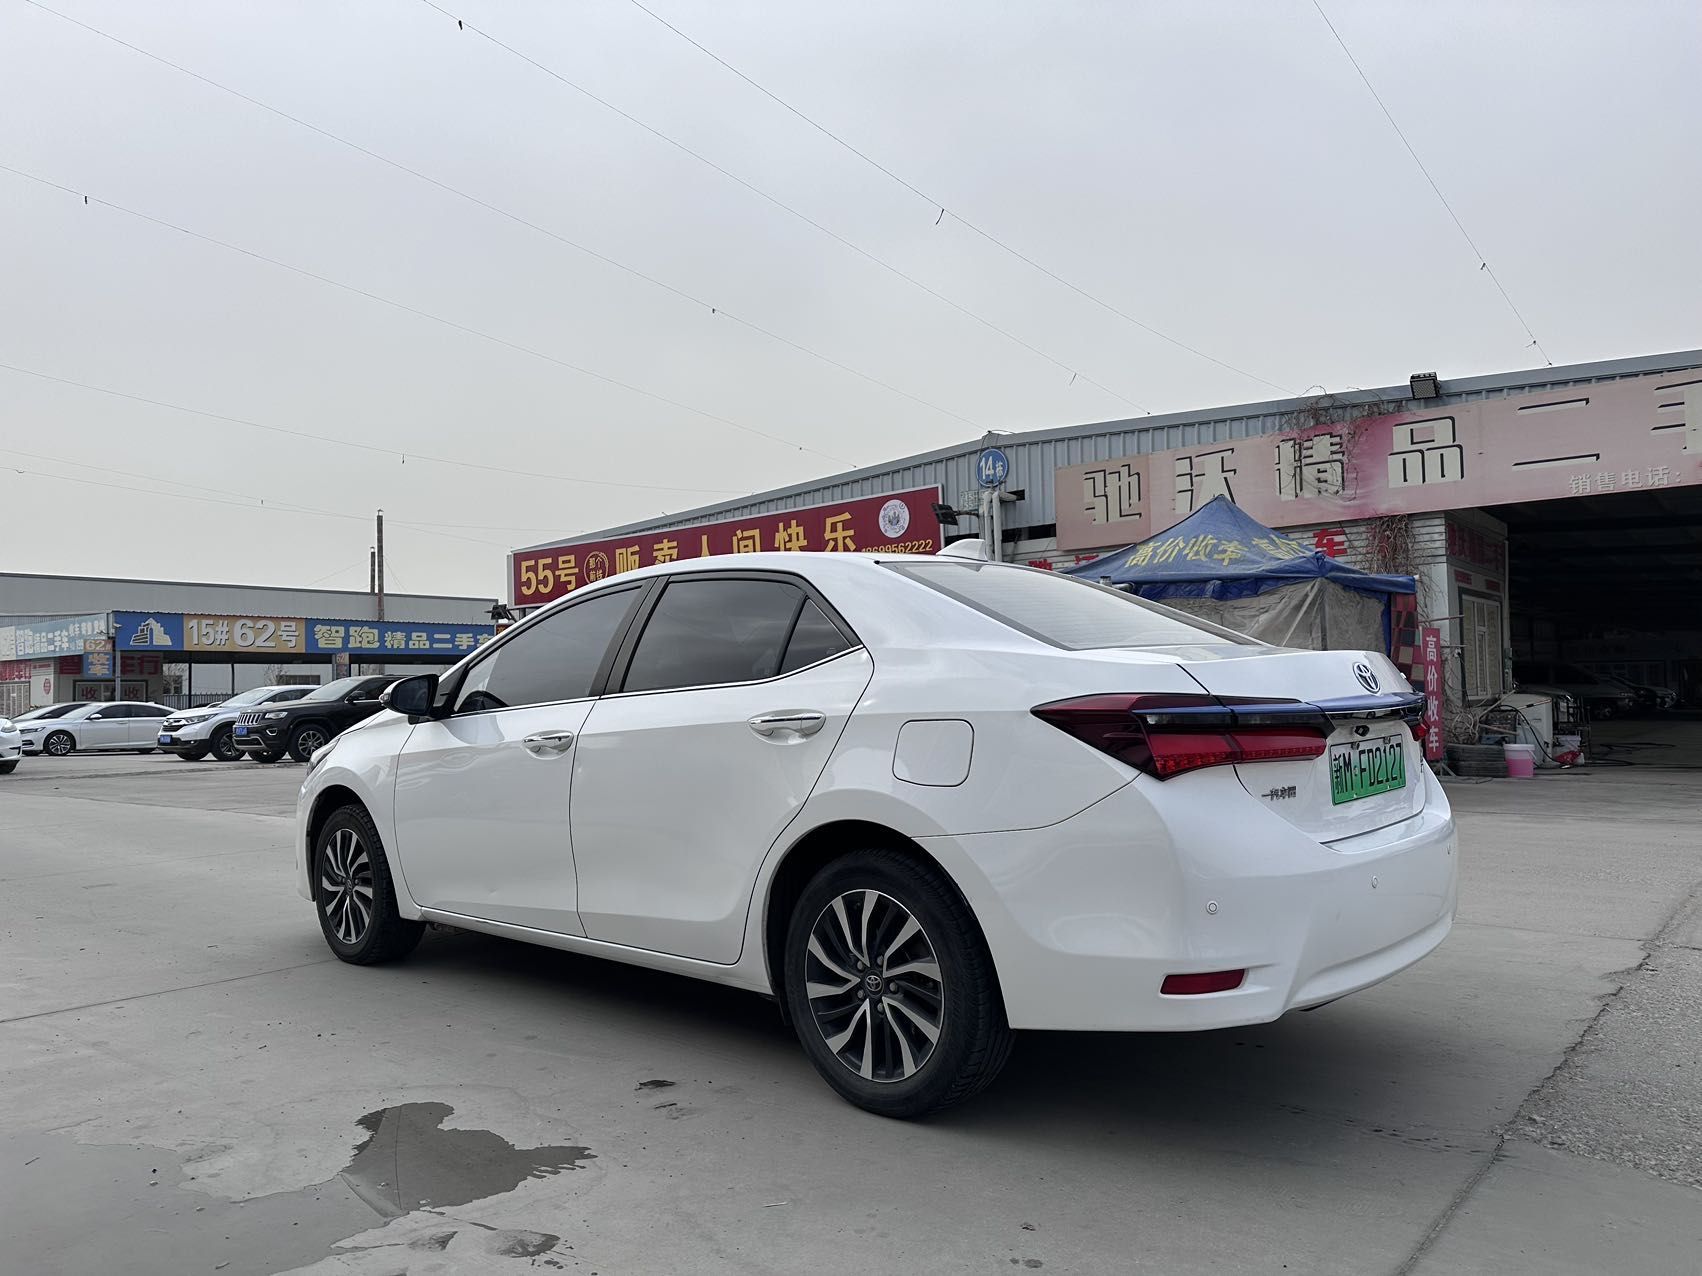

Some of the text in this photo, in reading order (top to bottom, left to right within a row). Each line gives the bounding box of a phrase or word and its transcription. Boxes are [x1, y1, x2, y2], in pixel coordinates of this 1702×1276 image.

[521, 554, 579, 596] 55号
[189, 619, 229, 648] 15#
[313, 624, 380, 649] 智跑
[1426, 634, 1440, 753] 高价收车
